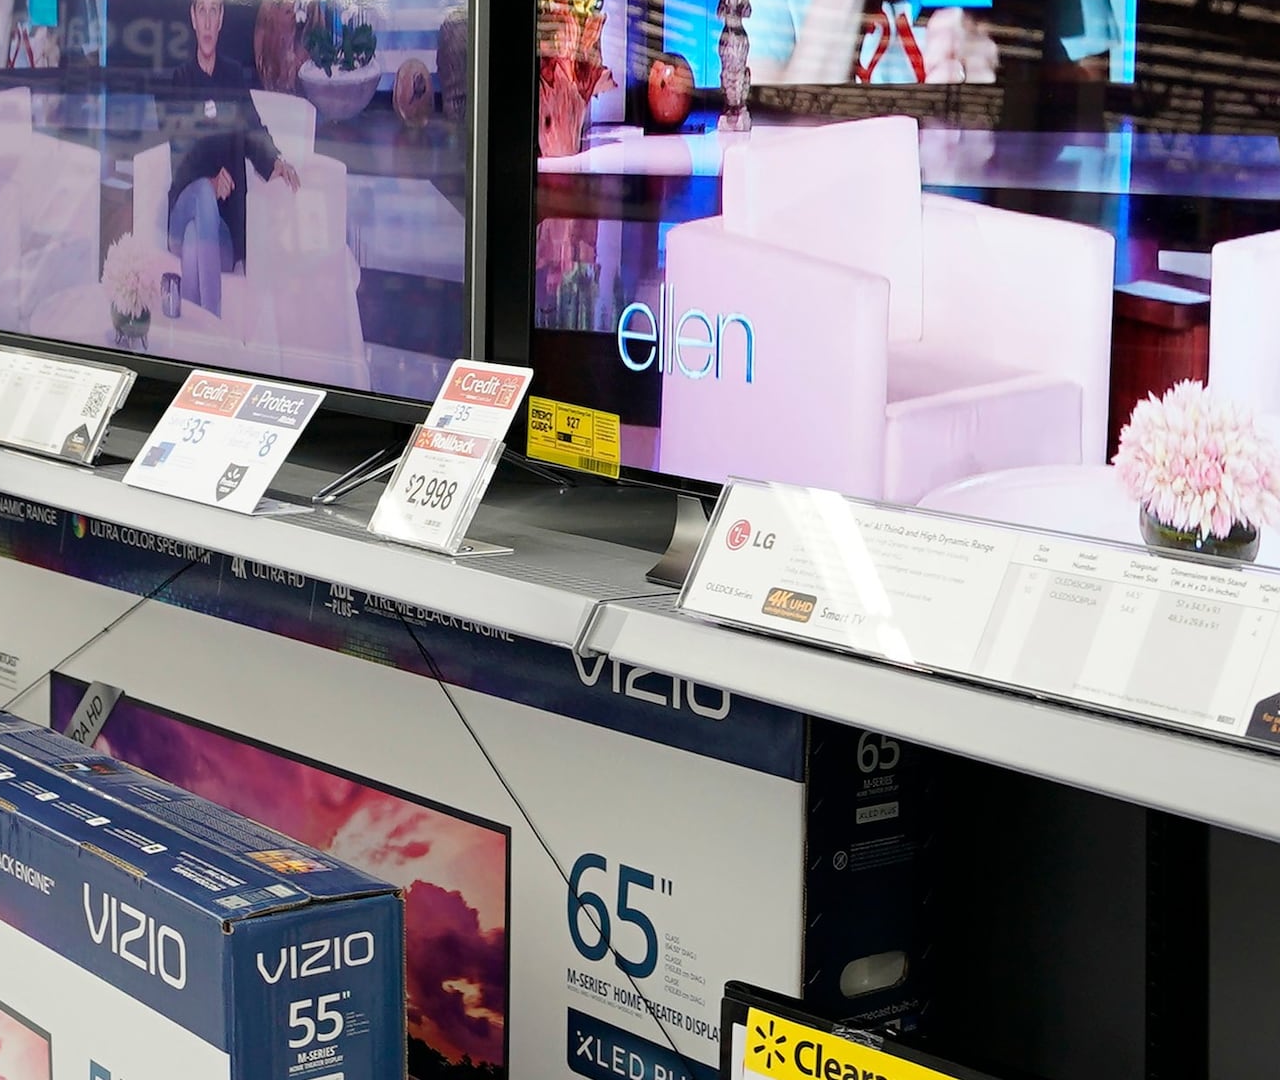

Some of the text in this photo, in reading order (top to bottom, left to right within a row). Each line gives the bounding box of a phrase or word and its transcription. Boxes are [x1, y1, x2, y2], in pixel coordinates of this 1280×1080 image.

[617, 282, 756, 384] ellen
[182, 417, 211, 445] $35
[566, 416, 581, 430] $27
[258, 430, 279, 458] $8
[430, 433, 475, 455] Rollback
[405, 473, 458, 511] $2,998
[26, 506, 58, 527] RANGE
[90, 520, 120, 541] ULTRA
[120, 527, 157, 552] COLOR
[752, 531, 776, 551] LG
[905, 528, 920, 538] and
[920, 531, 938, 543] High
[938, 534, 971, 549] Dynamic
[972, 539, 995, 553] Range
[1072, 562, 1097, 572] Number
[1079, 551, 1098, 561] Model
[1130, 560, 1158, 572] Diagonal
[231, 556, 246, 580] 4K
[286, 573, 306, 589] HD
[1123, 571, 1146, 583] Screen
[1171, 567, 1248, 588] Dimensions With Stand
[768, 589, 814, 614] 4K UHD
[820, 607, 850, 624] Smart
[87, 694, 104, 727] HD
[857, 731, 901, 774] 65
[567, 852, 673, 979] 65"
[83, 881, 187, 991] VIZIO
[256, 931, 375, 985] VIZIO
[288, 990, 351, 1049] 55"
[613, 986, 642, 1012] HOME
[644, 999, 684, 1030] THEATER
[576, 1030, 645, 1080] XLED
